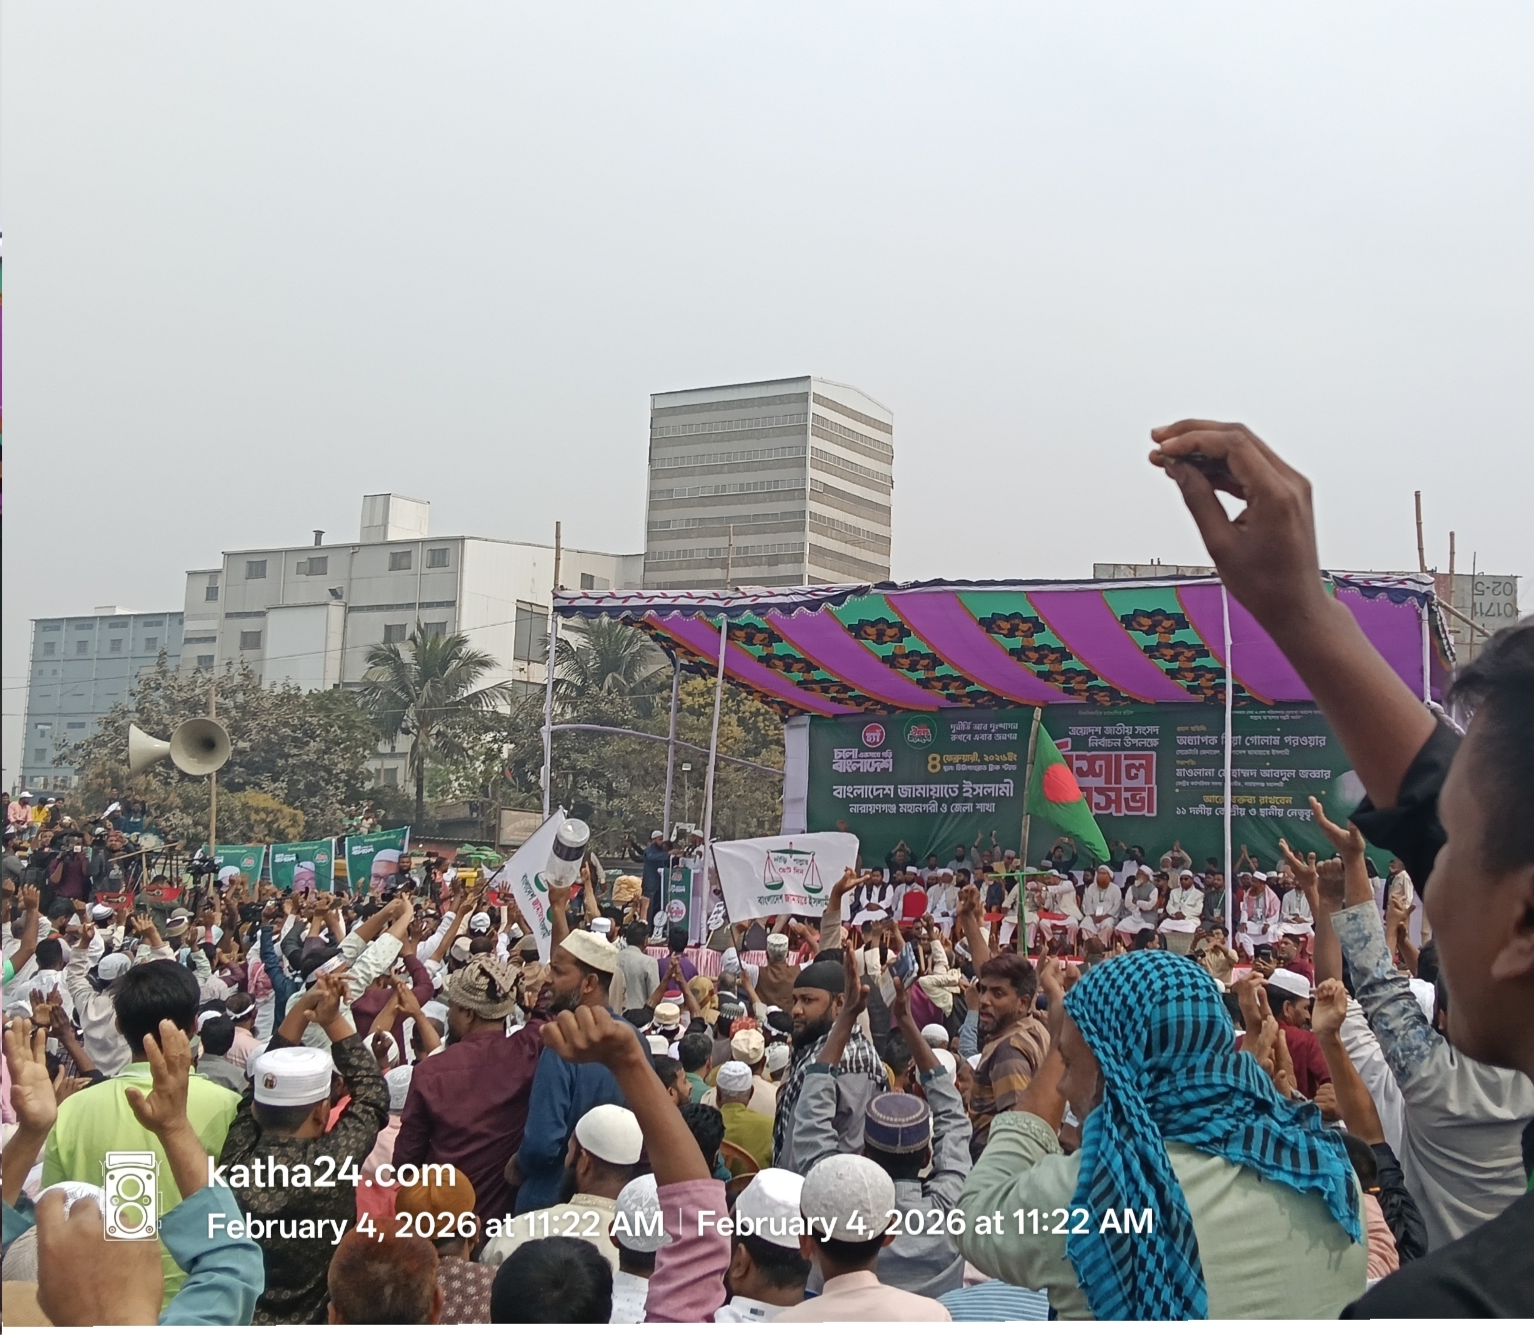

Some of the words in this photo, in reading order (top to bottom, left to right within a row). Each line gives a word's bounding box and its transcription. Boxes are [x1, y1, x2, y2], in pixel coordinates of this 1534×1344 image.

[1103, 722, 1133, 736] জাতীয়
[1134, 725, 1160, 736] সংসদ
[1088, 736, 1122, 748] নির্বাচন
[1123, 736, 1160, 748] উপলক্ষে
[1176, 735, 1218, 746] অধ্যাপক
[1244, 735, 1281, 746] গোলাম
[1283, 735, 1327, 747] পরওয়ার
[832, 758, 893, 773] বাংলাদেশ
[1175, 768, 1215, 778] মাওলানা
[1259, 768, 1296, 781] আবদুল
[832, 784, 894, 799] বাংলাদেশ
[897, 783, 959, 800] জামায়াতে
[962, 778, 1014, 798] ইসলামী
[849, 802, 897, 815] নারায়ণগঞ্জ
[899, 800, 939, 814] মহানগরী
[940, 803, 948, 813] ও
[950, 802, 974, 813] জেলা
[975, 802, 996, 813] শাখা
[1189, 804, 1212, 816] দলীয়
[1248, 807, 1257, 816] ও
